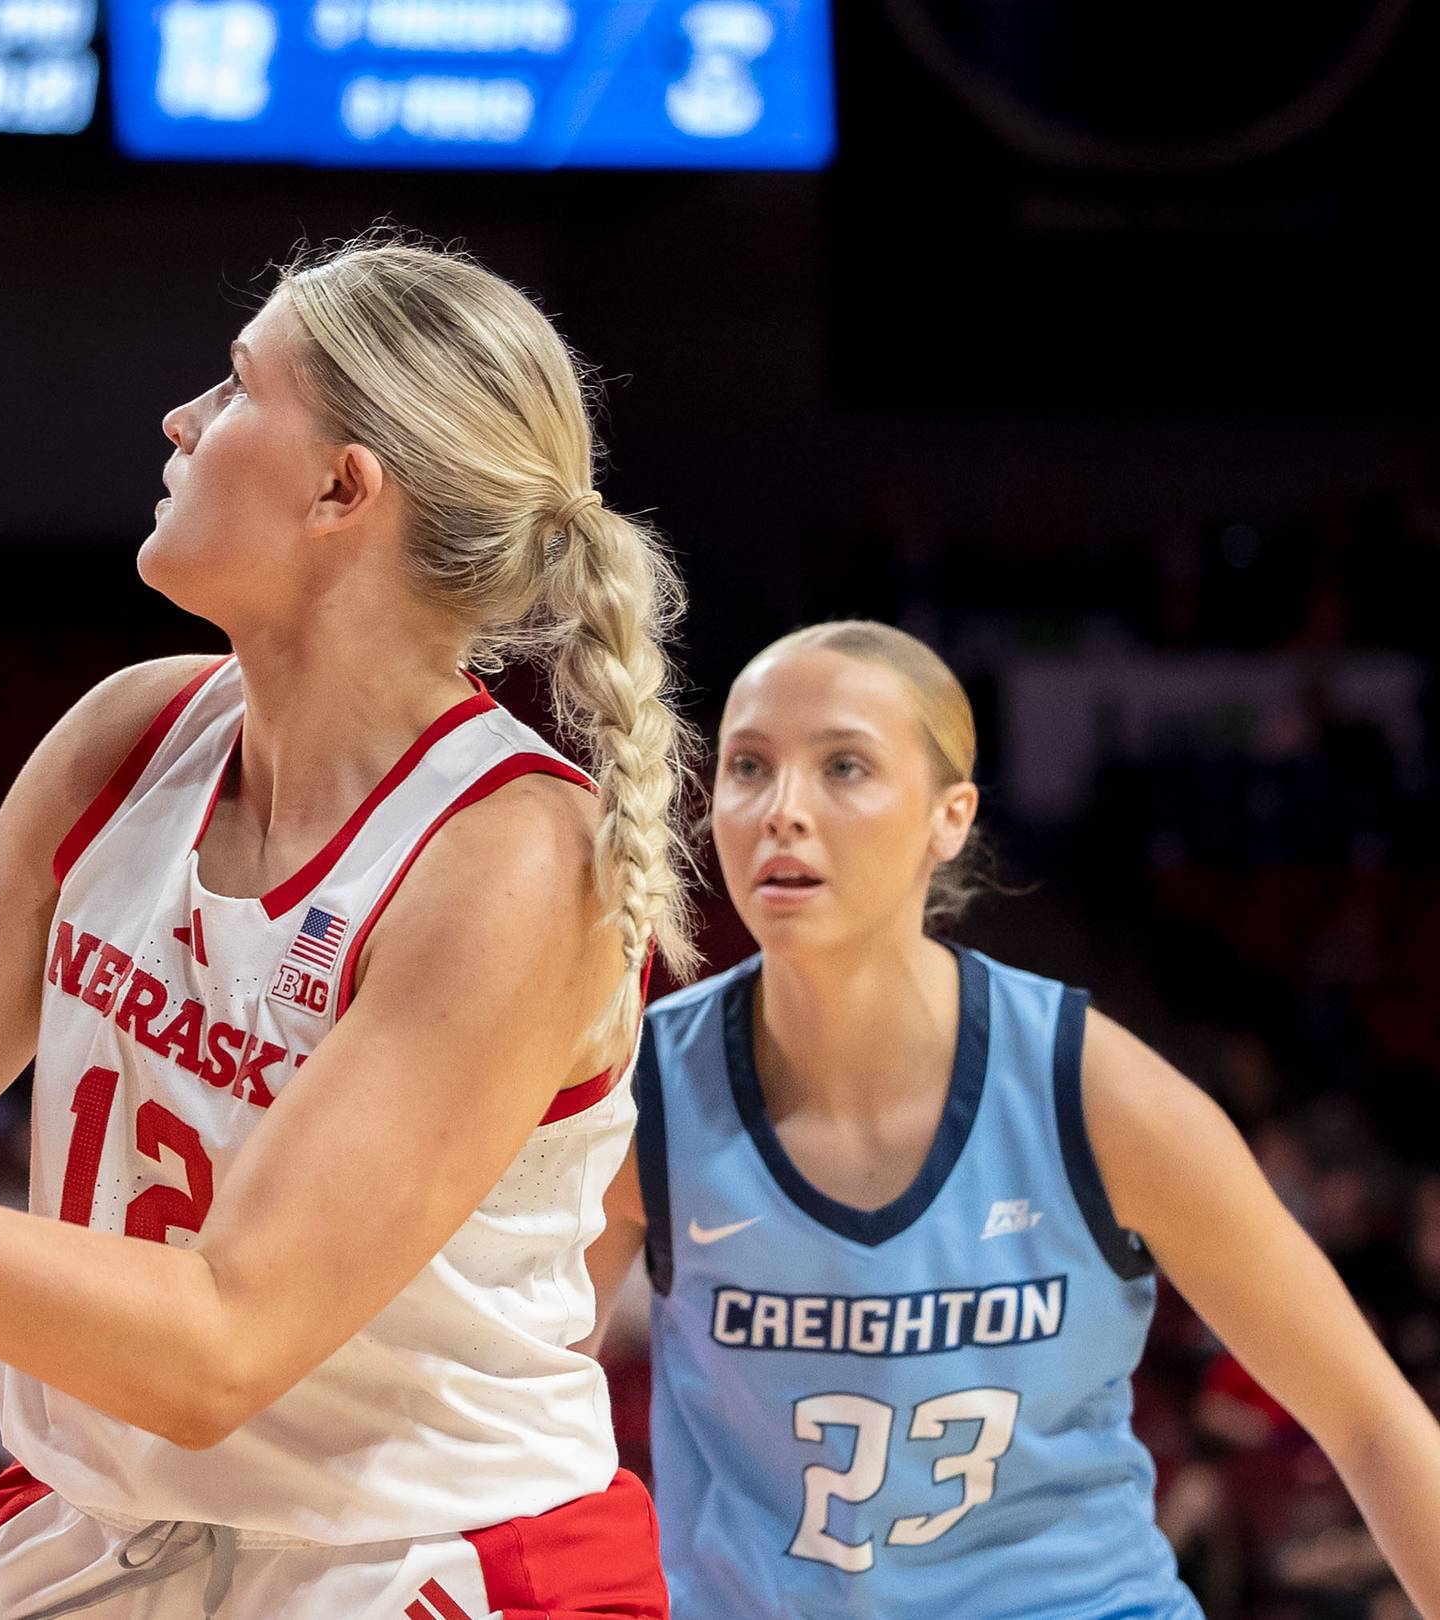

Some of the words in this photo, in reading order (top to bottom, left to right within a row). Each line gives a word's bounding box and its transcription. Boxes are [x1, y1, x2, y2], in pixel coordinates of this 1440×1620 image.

[59, 1065, 214, 1244] 12
[711, 1276, 1066, 1357] CREIGHTON
[787, 1386, 1021, 1573] 23
